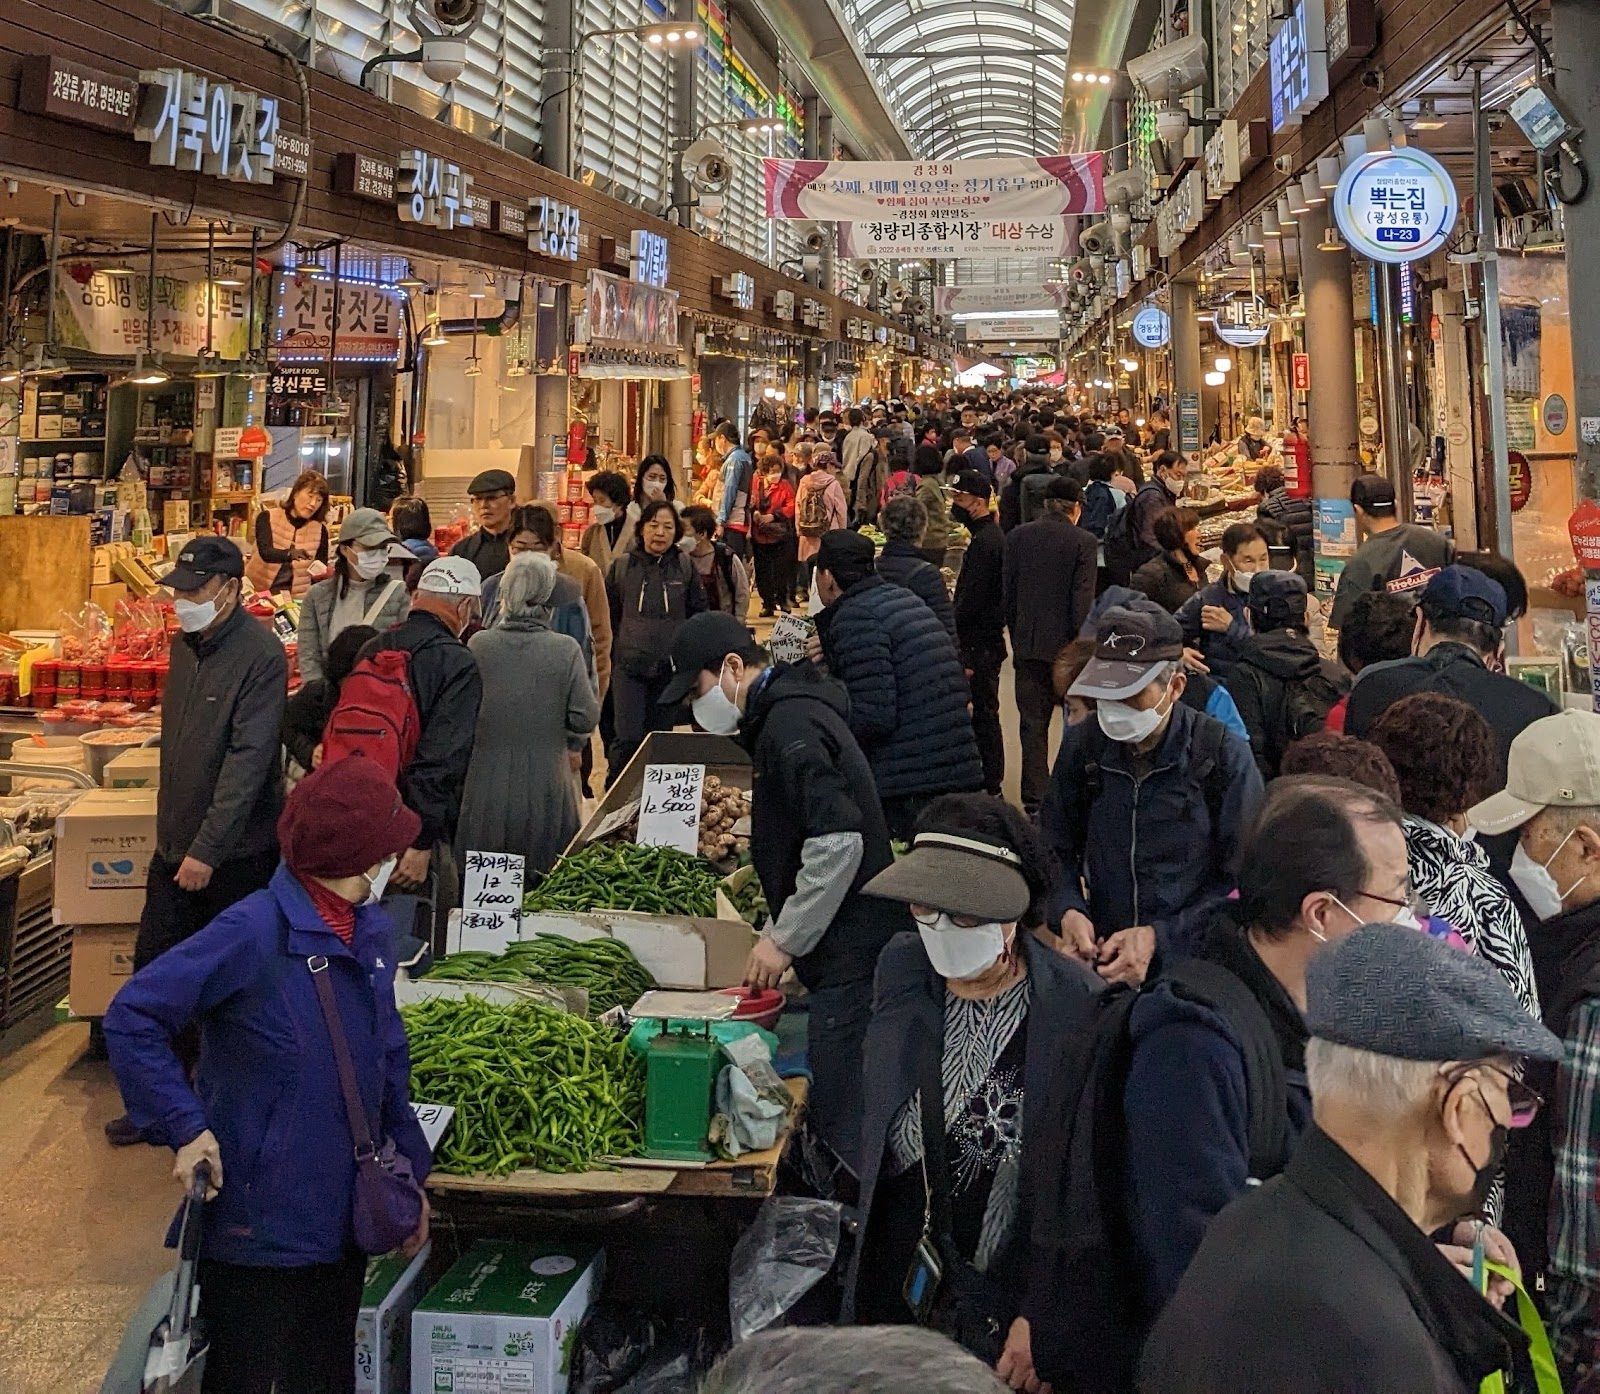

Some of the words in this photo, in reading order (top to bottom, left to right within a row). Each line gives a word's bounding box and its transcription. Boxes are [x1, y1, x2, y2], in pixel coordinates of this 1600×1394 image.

[150, 68, 281, 182] 거북이젓갈
[1369, 187, 1425, 210] 뽁는집
[992, 222, 1022, 240] 대상
[1025, 222, 1054, 240] 수상
[1384, 229, 1413, 240] 나-23
[272, 376, 327, 394] 창신푸드
[473, 891, 515, 907] 4000
[431, 1332, 456, 1340] DREAM
